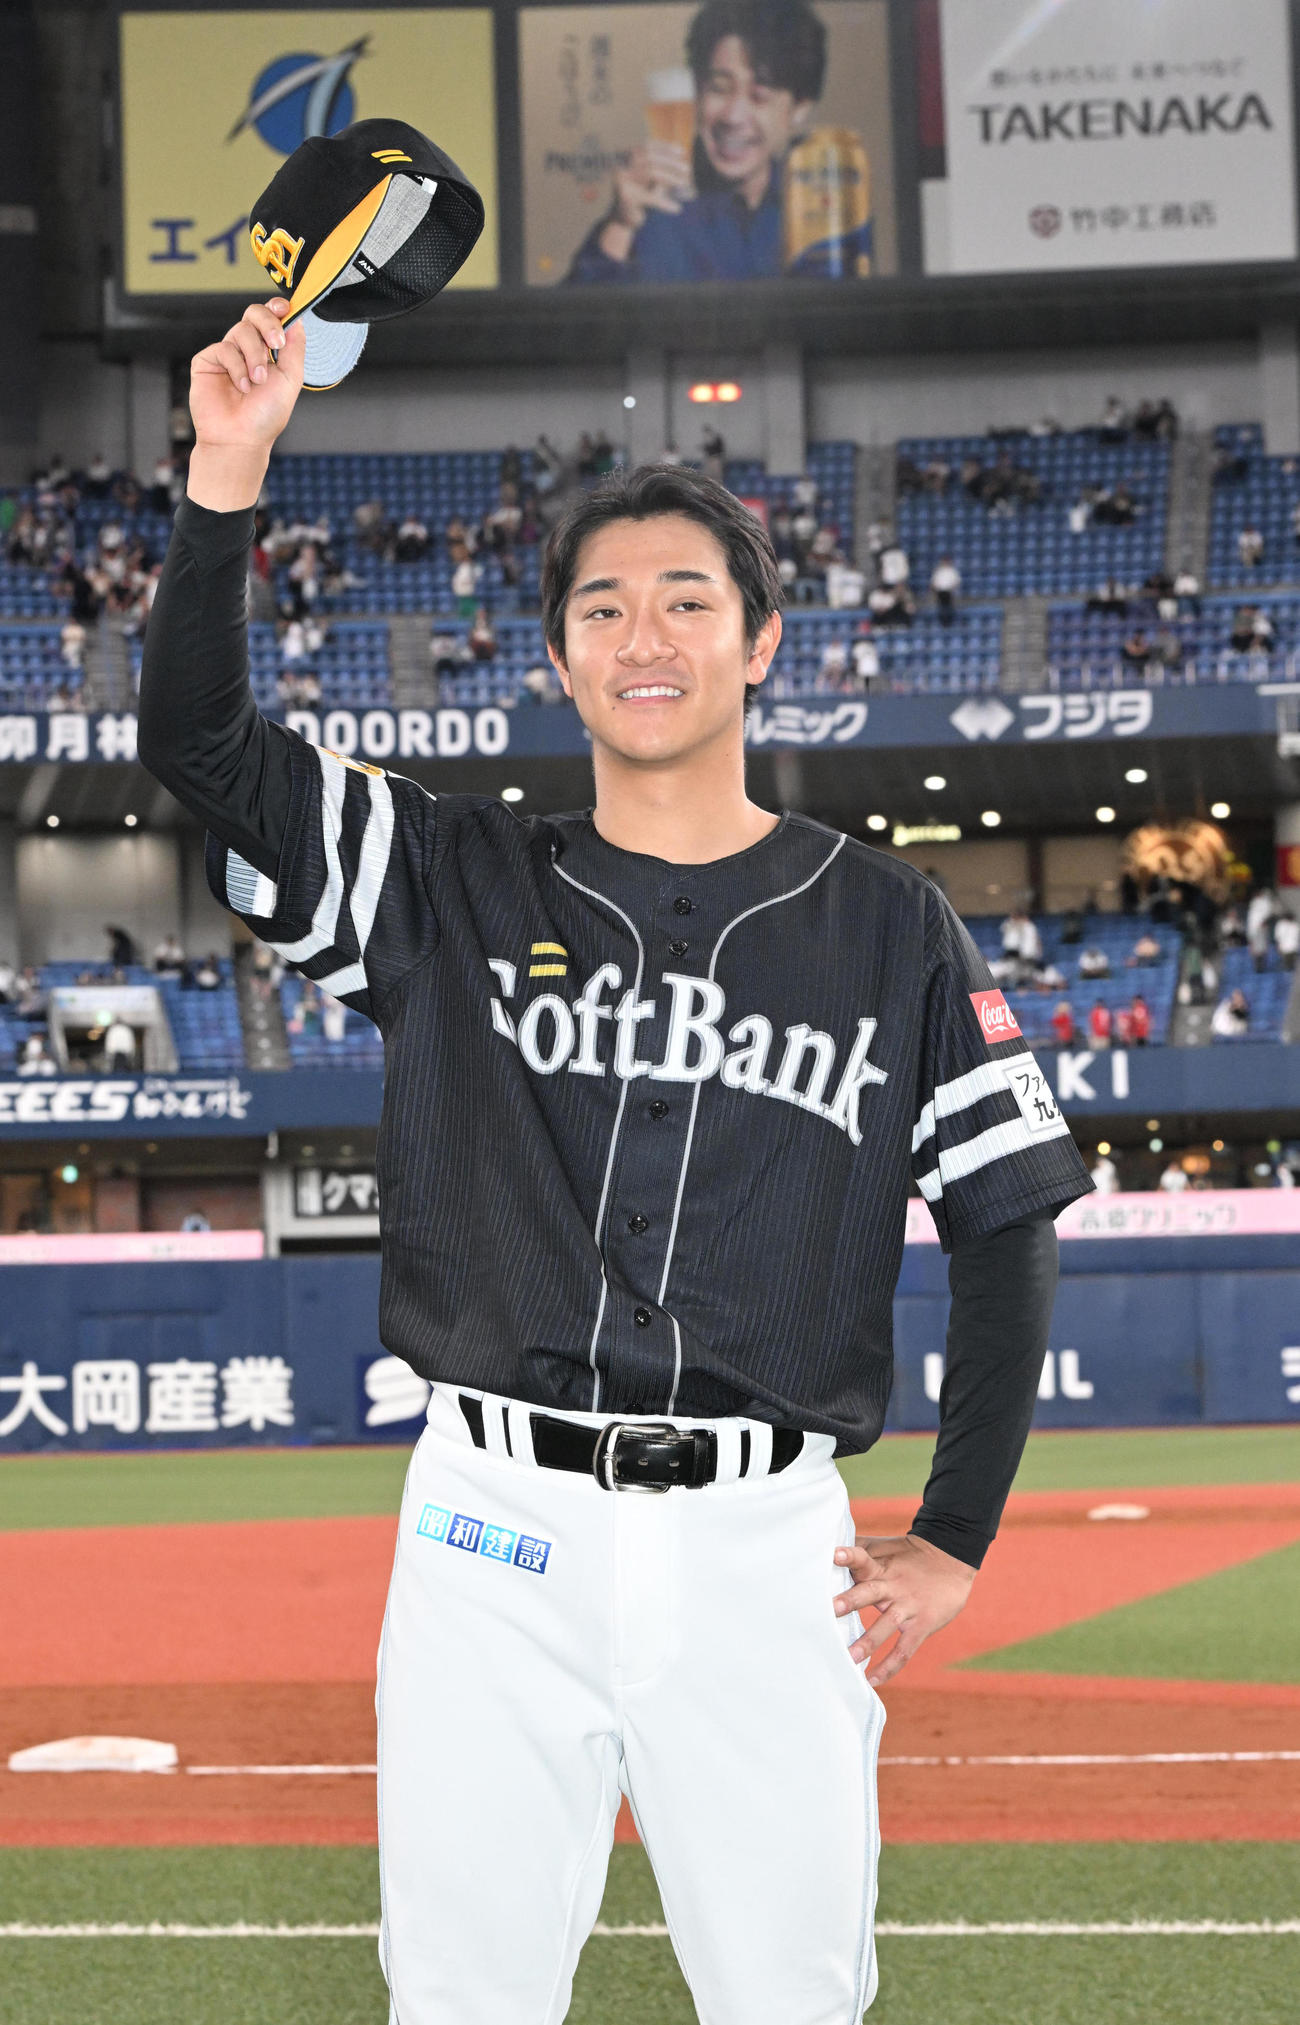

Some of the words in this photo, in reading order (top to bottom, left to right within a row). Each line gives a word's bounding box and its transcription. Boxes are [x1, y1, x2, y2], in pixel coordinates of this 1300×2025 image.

[971, 91, 1272, 145] TAKENAKA
[1019, 690, 1152, 740] フジタ
[1015, 1073, 1046, 1098] ファ
[0, 1356, 295, 1437] 大岡産業
[416, 1504, 552, 1575] 昭和建設
